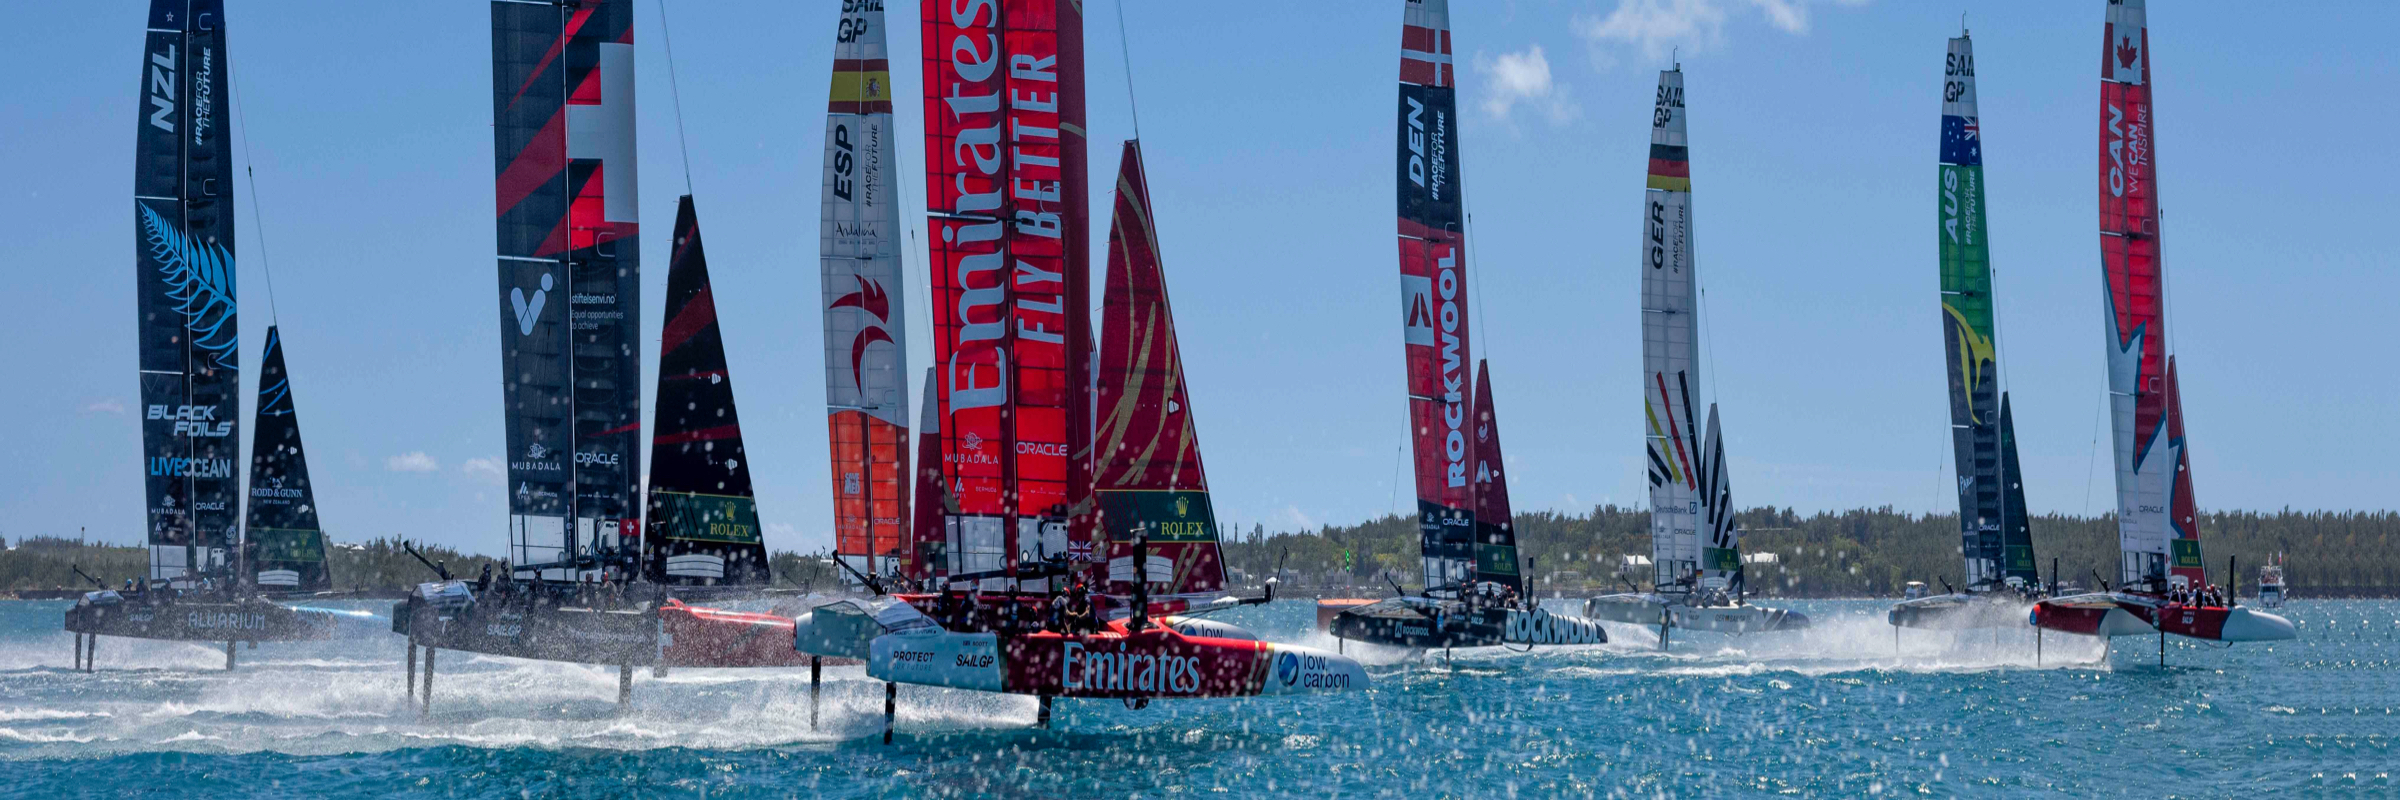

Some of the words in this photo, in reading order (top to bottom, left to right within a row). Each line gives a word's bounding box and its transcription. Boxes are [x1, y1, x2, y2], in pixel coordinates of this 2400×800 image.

[838, 18, 868, 43] GP
[1946, 52, 1975, 77] SAIL
[150, 44, 175, 133] NZL
[202, 46, 210, 128] THEFUTURE
[1656, 85, 1685, 108] SAIL
[1944, 81, 1965, 103] GP
[195, 71, 203, 146] #RACEFOR
[1653, 107, 1672, 128] GP
[1010, 53, 1062, 238] BETTER
[1408, 96, 1424, 188] DEN
[2128, 124, 2138, 166] CAN
[2138, 104, 2148, 166] INSPIRE
[2108, 103, 2124, 198] CAN
[834, 124, 854, 202] ESP
[1430, 132, 1439, 200] #RACEFOR
[2129, 166, 2138, 194] WE
[942, 0, 1006, 416] Emirates
[1944, 168, 1958, 244] AUS
[1652, 200, 1664, 270] GER
[1018, 260, 1064, 344] FLY
[588, 310, 623, 319] opportunities
[578, 322, 598, 330] achieve
[1438, 247, 1466, 488] ROCKWOOL
[147, 405, 217, 420] BLACK
[174, 422, 232, 437] FOILS
[576, 452, 618, 464] ORACLE
[944, 454, 999, 464] MUBADALA
[1016, 442, 1068, 456] ORACLE
[151, 456, 230, 478] LIVEOCEAN
[512, 462, 560, 471] MUBADALA
[251, 488, 273, 497] RODD
[274, 488, 279, 498] &
[280, 489, 303, 498] GUNN
[196, 502, 224, 510] ORACLE
[710, 522, 749, 537] ROLEX
[874, 517, 900, 525] ORACLE
[1161, 522, 1204, 536] ROLEX
[1442, 518, 1469, 526] ORACLE
[1494, 562, 1512, 571] ROLEX
[2181, 556, 2198, 564] ROLEX
[1201, 624, 1223, 638] low
[1403, 626, 1429, 636] ROCKWOOL
[1504, 608, 1600, 644] ROCKWOOL
[893, 650, 935, 662] PROTECT
[1062, 641, 1200, 693] Emirates
[1303, 652, 1326, 670] low
[1304, 670, 1350, 689] carbon
